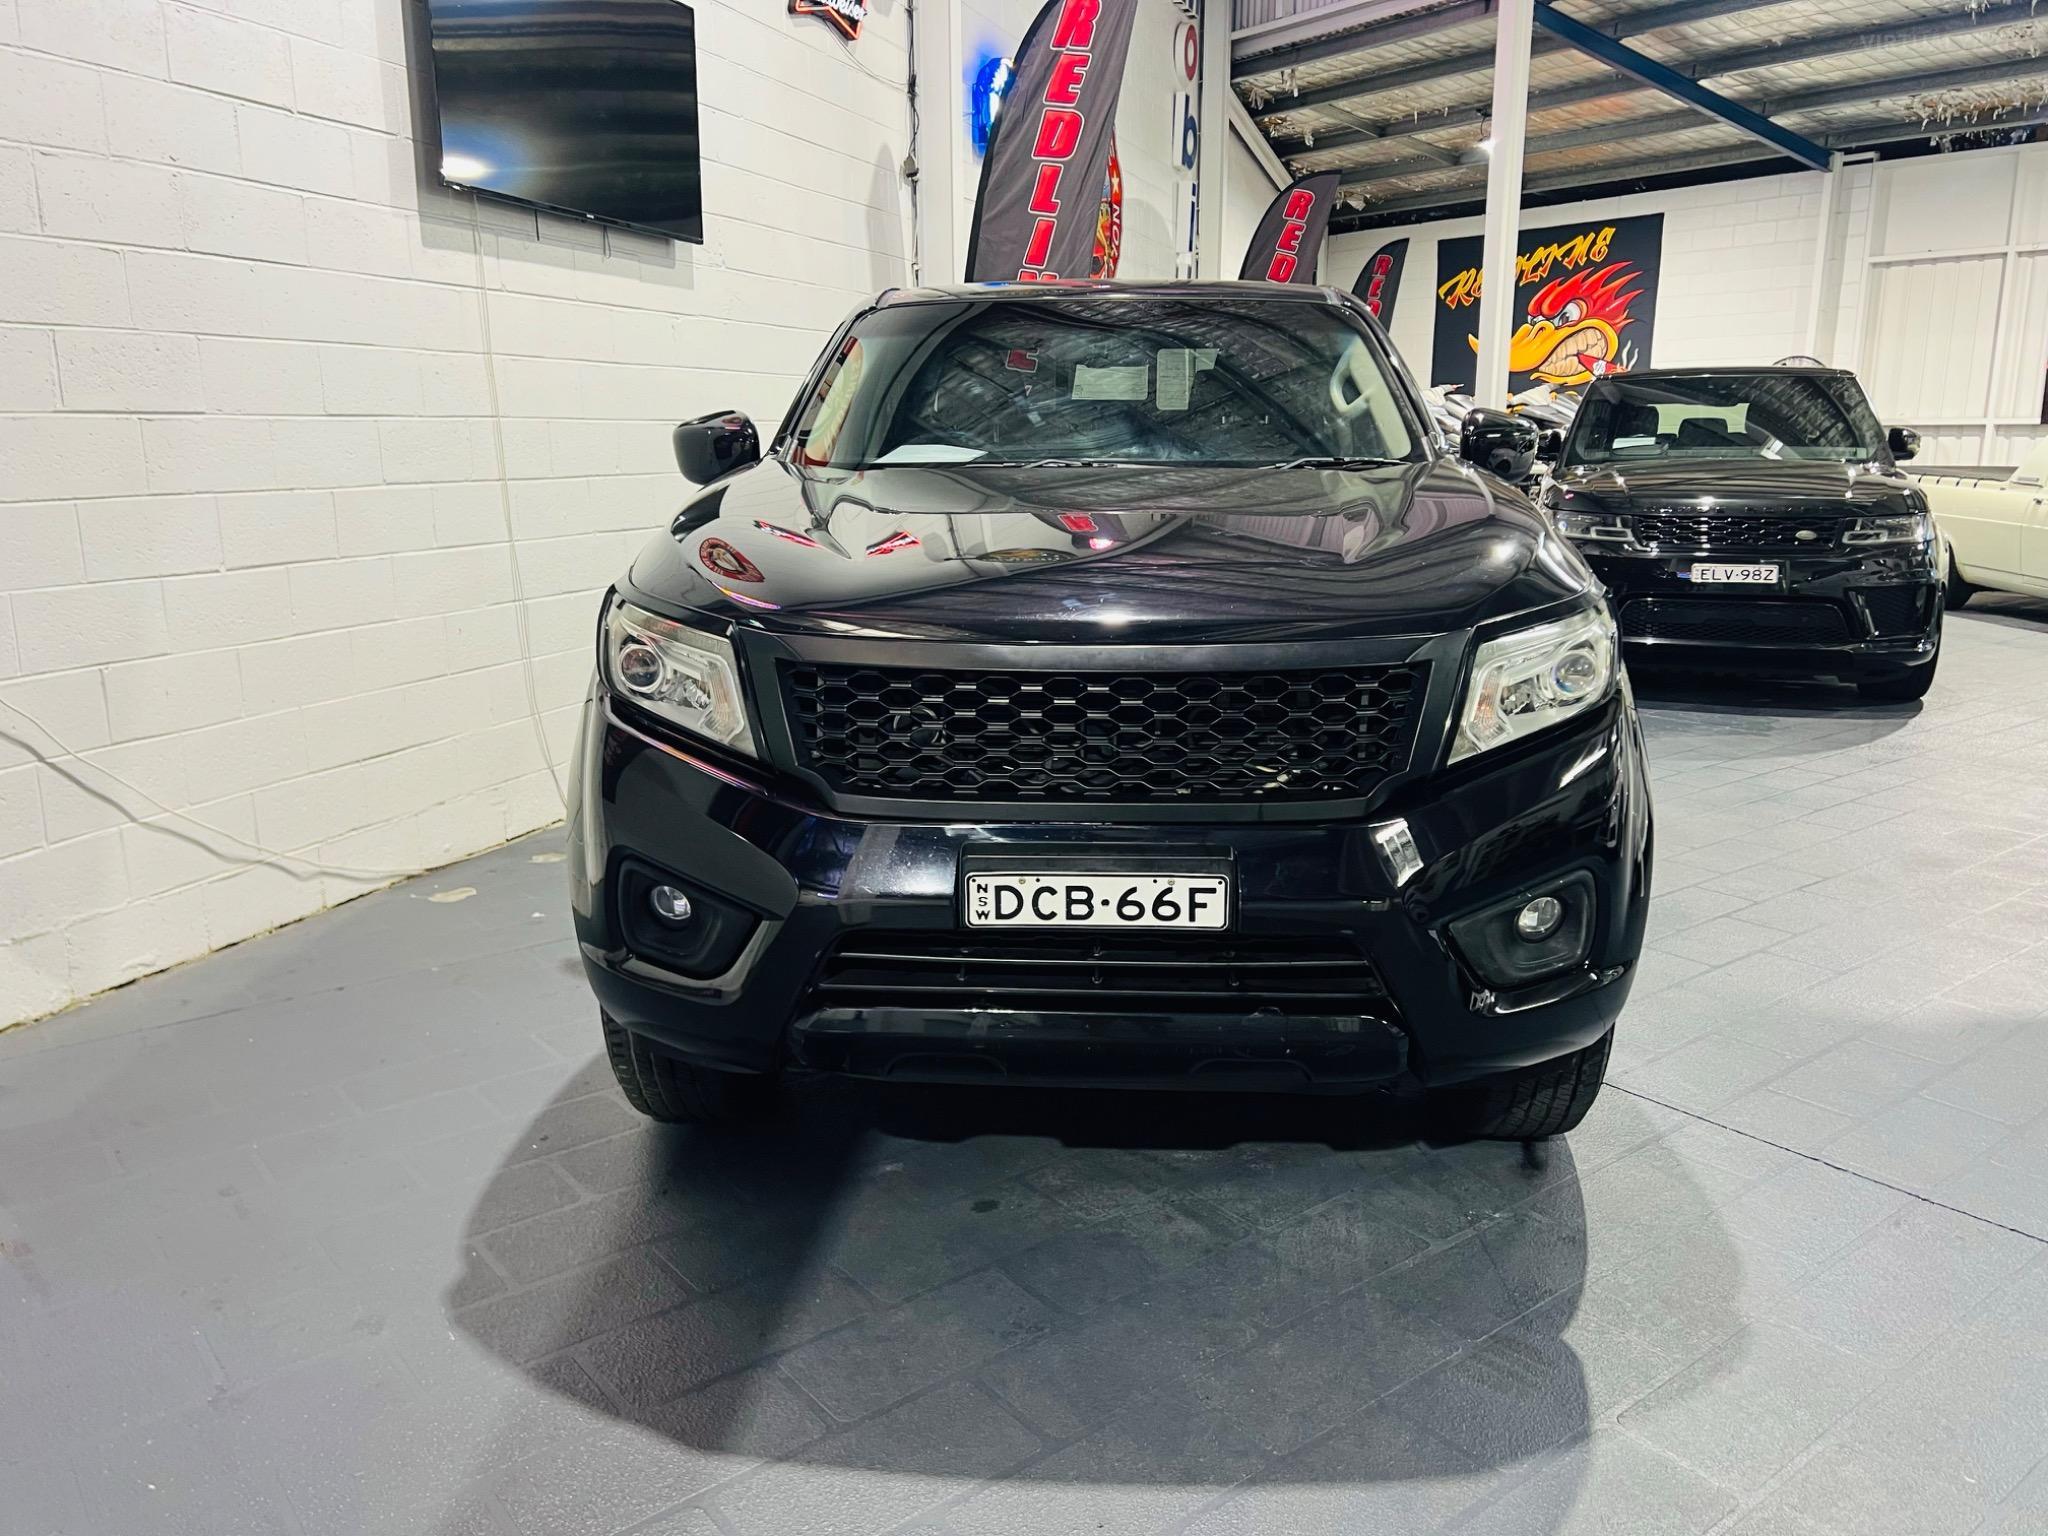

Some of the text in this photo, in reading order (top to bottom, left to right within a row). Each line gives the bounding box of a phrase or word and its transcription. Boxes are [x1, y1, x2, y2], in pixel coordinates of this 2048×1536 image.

[1017, 0, 1102, 281] REDLI
[1266, 188, 1316, 285] RED
[975, 883, 990, 921] NSW
